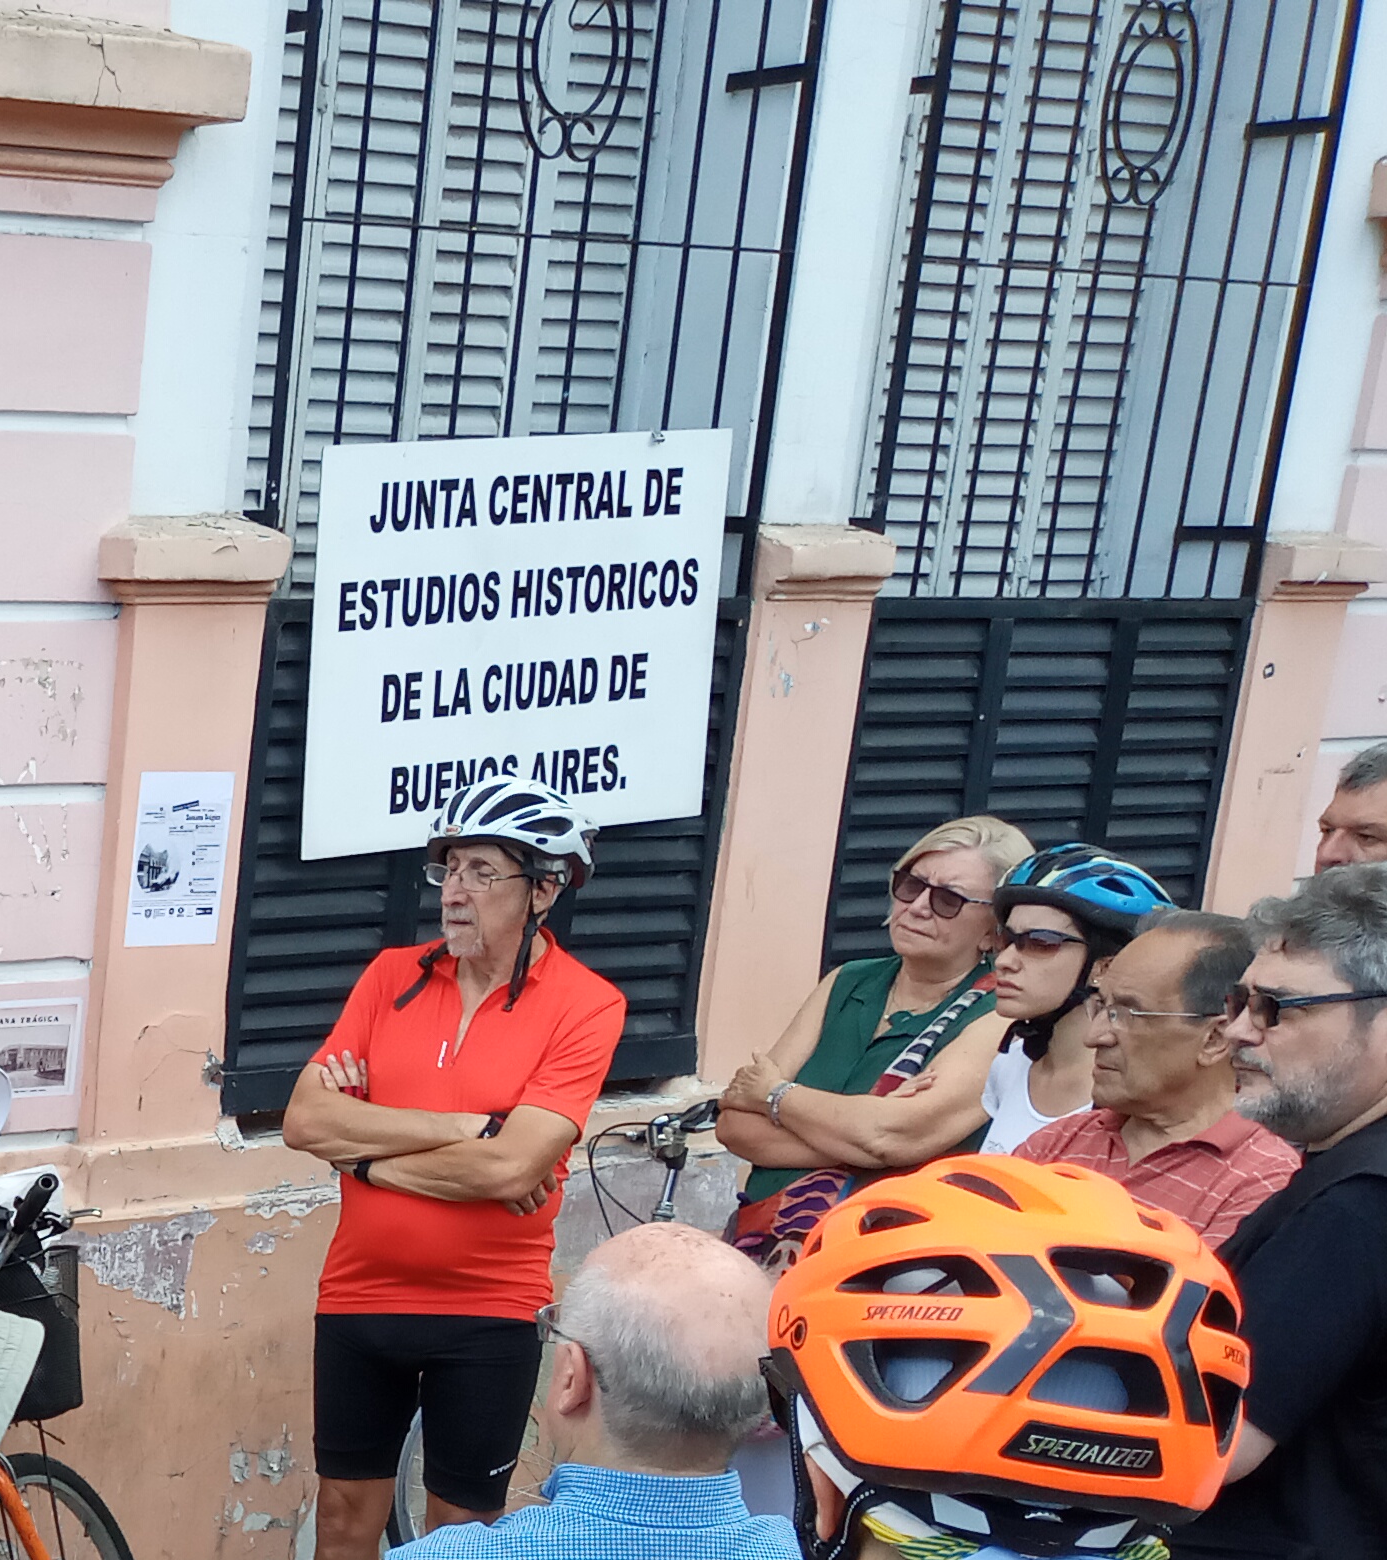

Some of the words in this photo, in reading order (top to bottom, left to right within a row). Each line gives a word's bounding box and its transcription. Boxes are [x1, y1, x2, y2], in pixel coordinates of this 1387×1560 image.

[369, 478, 477, 533] JUNTA
[488, 470, 632, 526] CENTRAL
[643, 467, 684, 517] DE
[338, 571, 500, 632] ESTUDIOS
[511, 558, 699, 619] HISTORICOS
[381, 671, 422, 723] DE
[433, 668, 472, 718] LA
[482, 656, 598, 713] CIUDAD
[608, 652, 648, 702] DE
[531, 744, 627, 796] AIRES.
[862, 1305, 964, 1321] SPECIALIZED
[1019, 1433, 1156, 1470] SPECIALIZED
